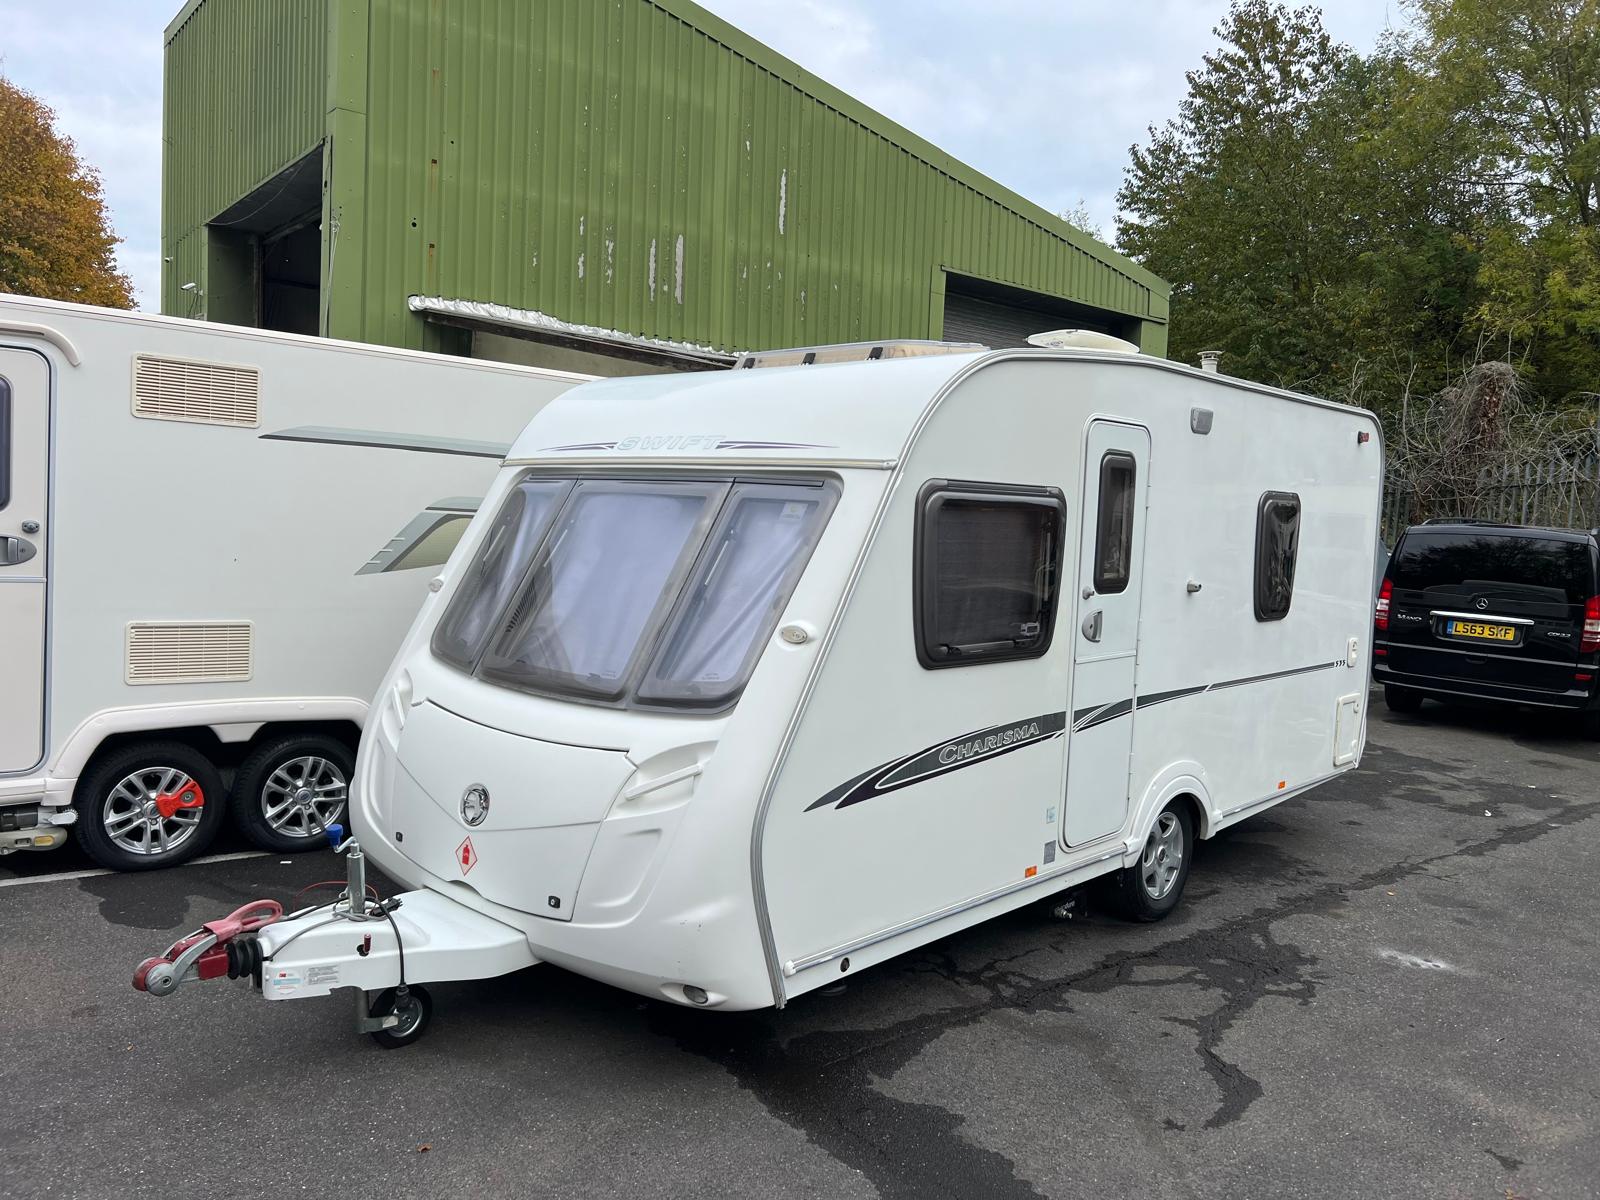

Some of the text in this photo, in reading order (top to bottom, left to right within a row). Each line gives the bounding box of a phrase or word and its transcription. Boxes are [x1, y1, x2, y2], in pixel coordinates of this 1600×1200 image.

[617, 435, 727, 450] SWIFT
[1454, 623, 1486, 636] LS63
[1487, 626, 1513, 638] SKF
[938, 723, 1040, 764] CHARISMA
